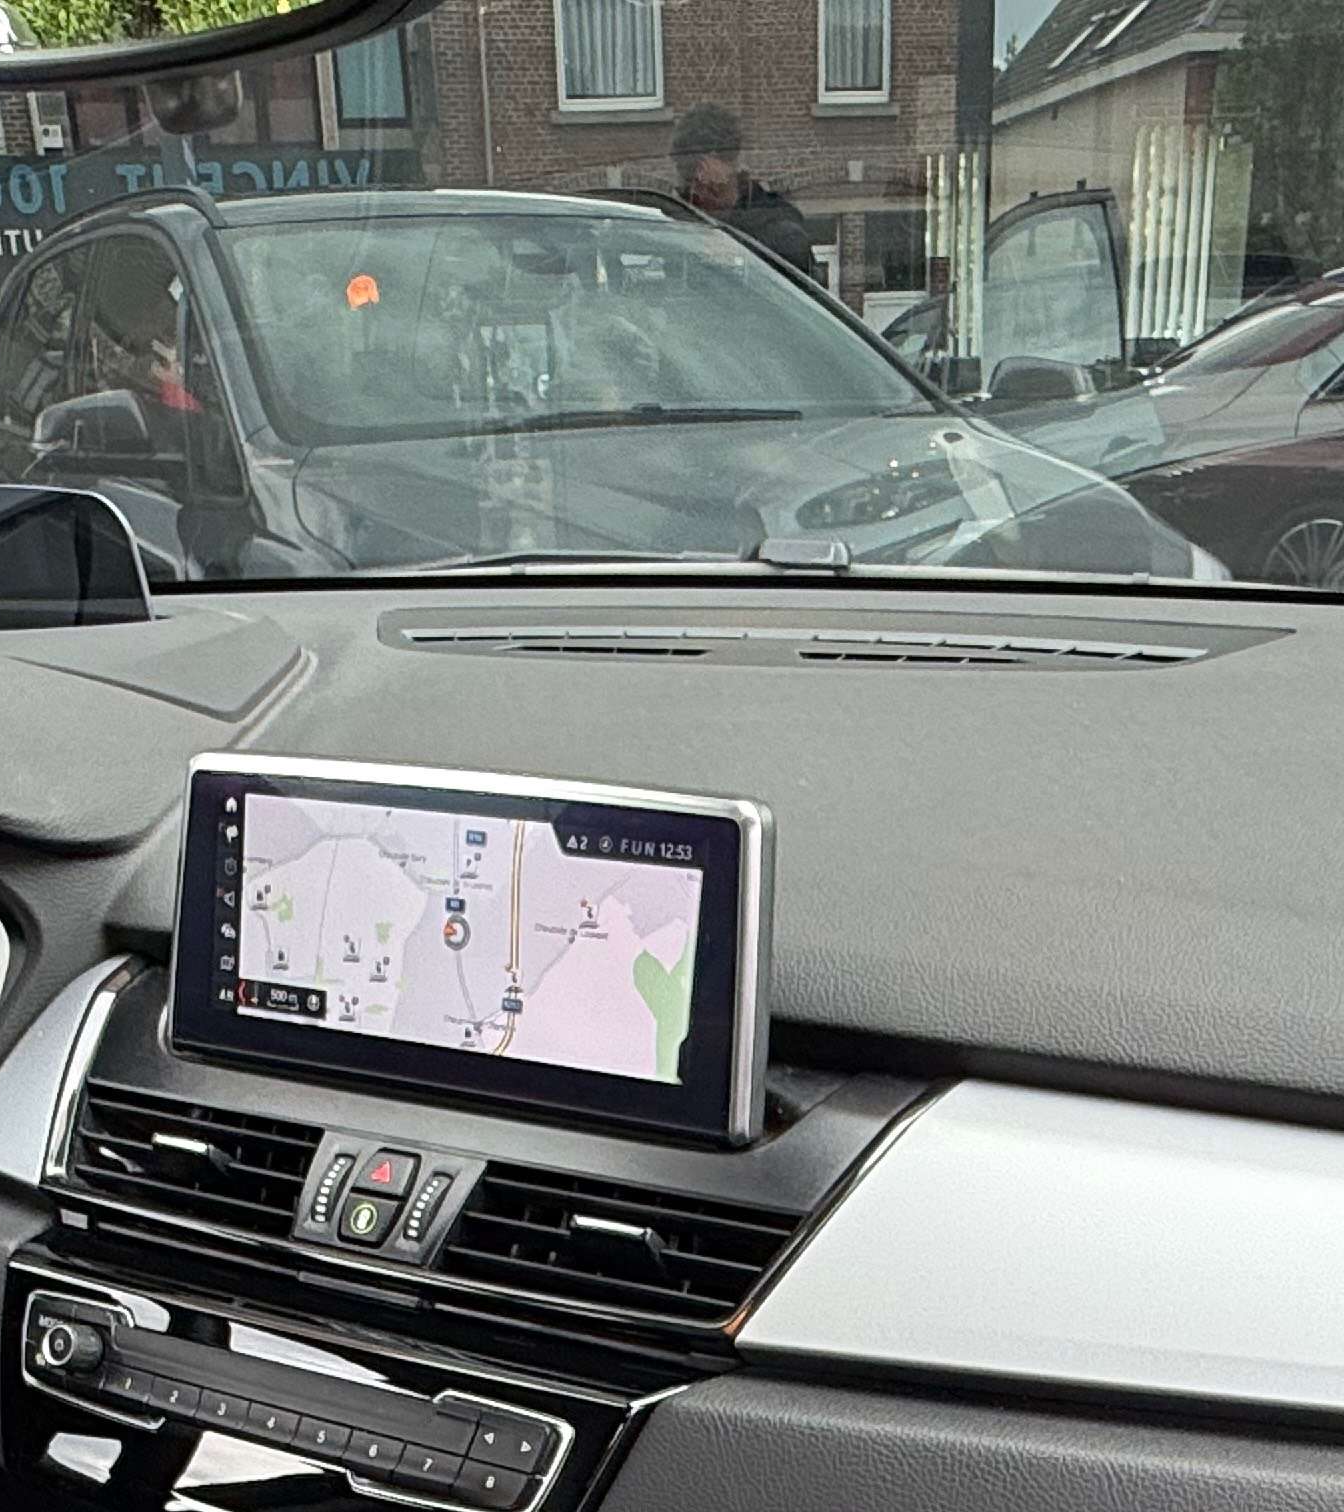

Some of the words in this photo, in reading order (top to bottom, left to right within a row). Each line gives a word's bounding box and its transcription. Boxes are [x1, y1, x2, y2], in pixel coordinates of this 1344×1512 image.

[619, 838, 656, 857] FUN
[169, 1390, 179, 1404] 2
[217, 1403, 227, 1416] 3
[266, 1416, 276, 1430] 4
[316, 1430, 327, 1444] 5
[368, 1444, 378, 1458] 6
[422, 1457, 433, 1472] 7
[484, 1475, 495, 1489] 8
